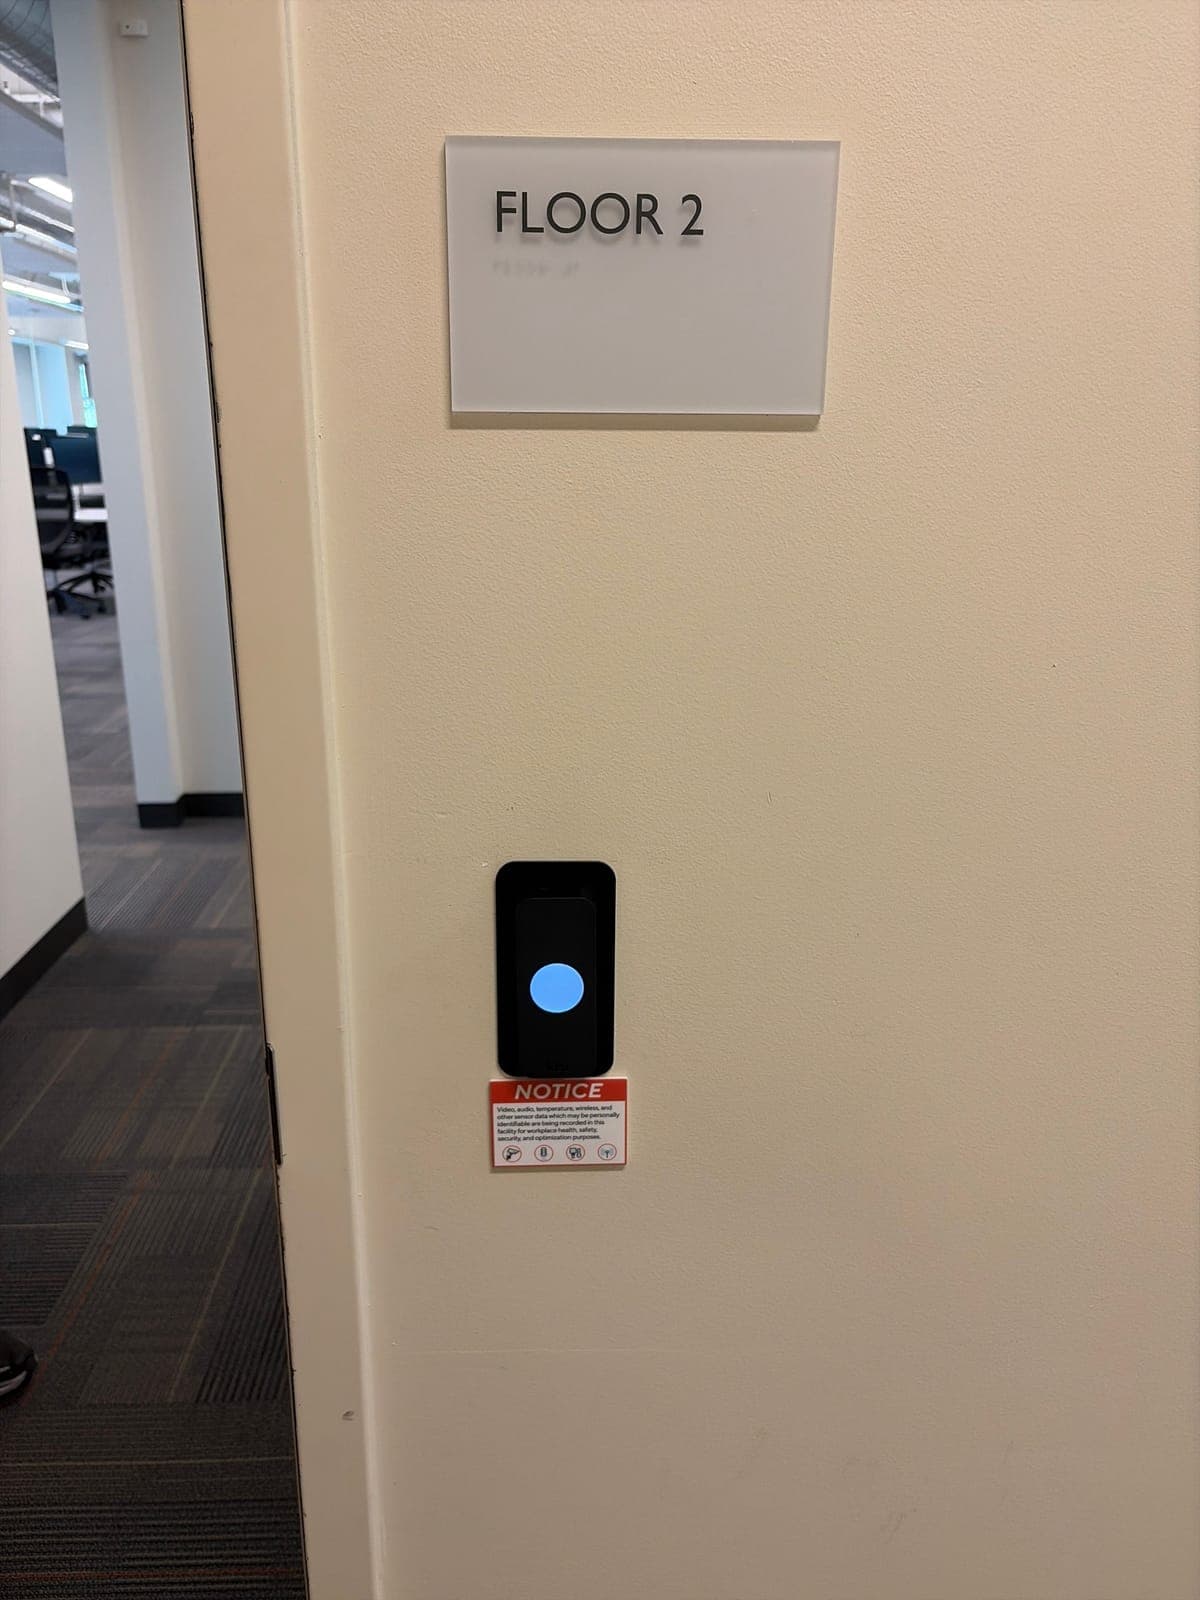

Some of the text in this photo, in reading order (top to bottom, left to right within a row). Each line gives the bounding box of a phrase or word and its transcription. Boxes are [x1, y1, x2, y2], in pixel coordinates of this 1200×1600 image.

[496, 190, 704, 236] FLOOR 2
[514, 1083, 604, 1100] NOTICE
